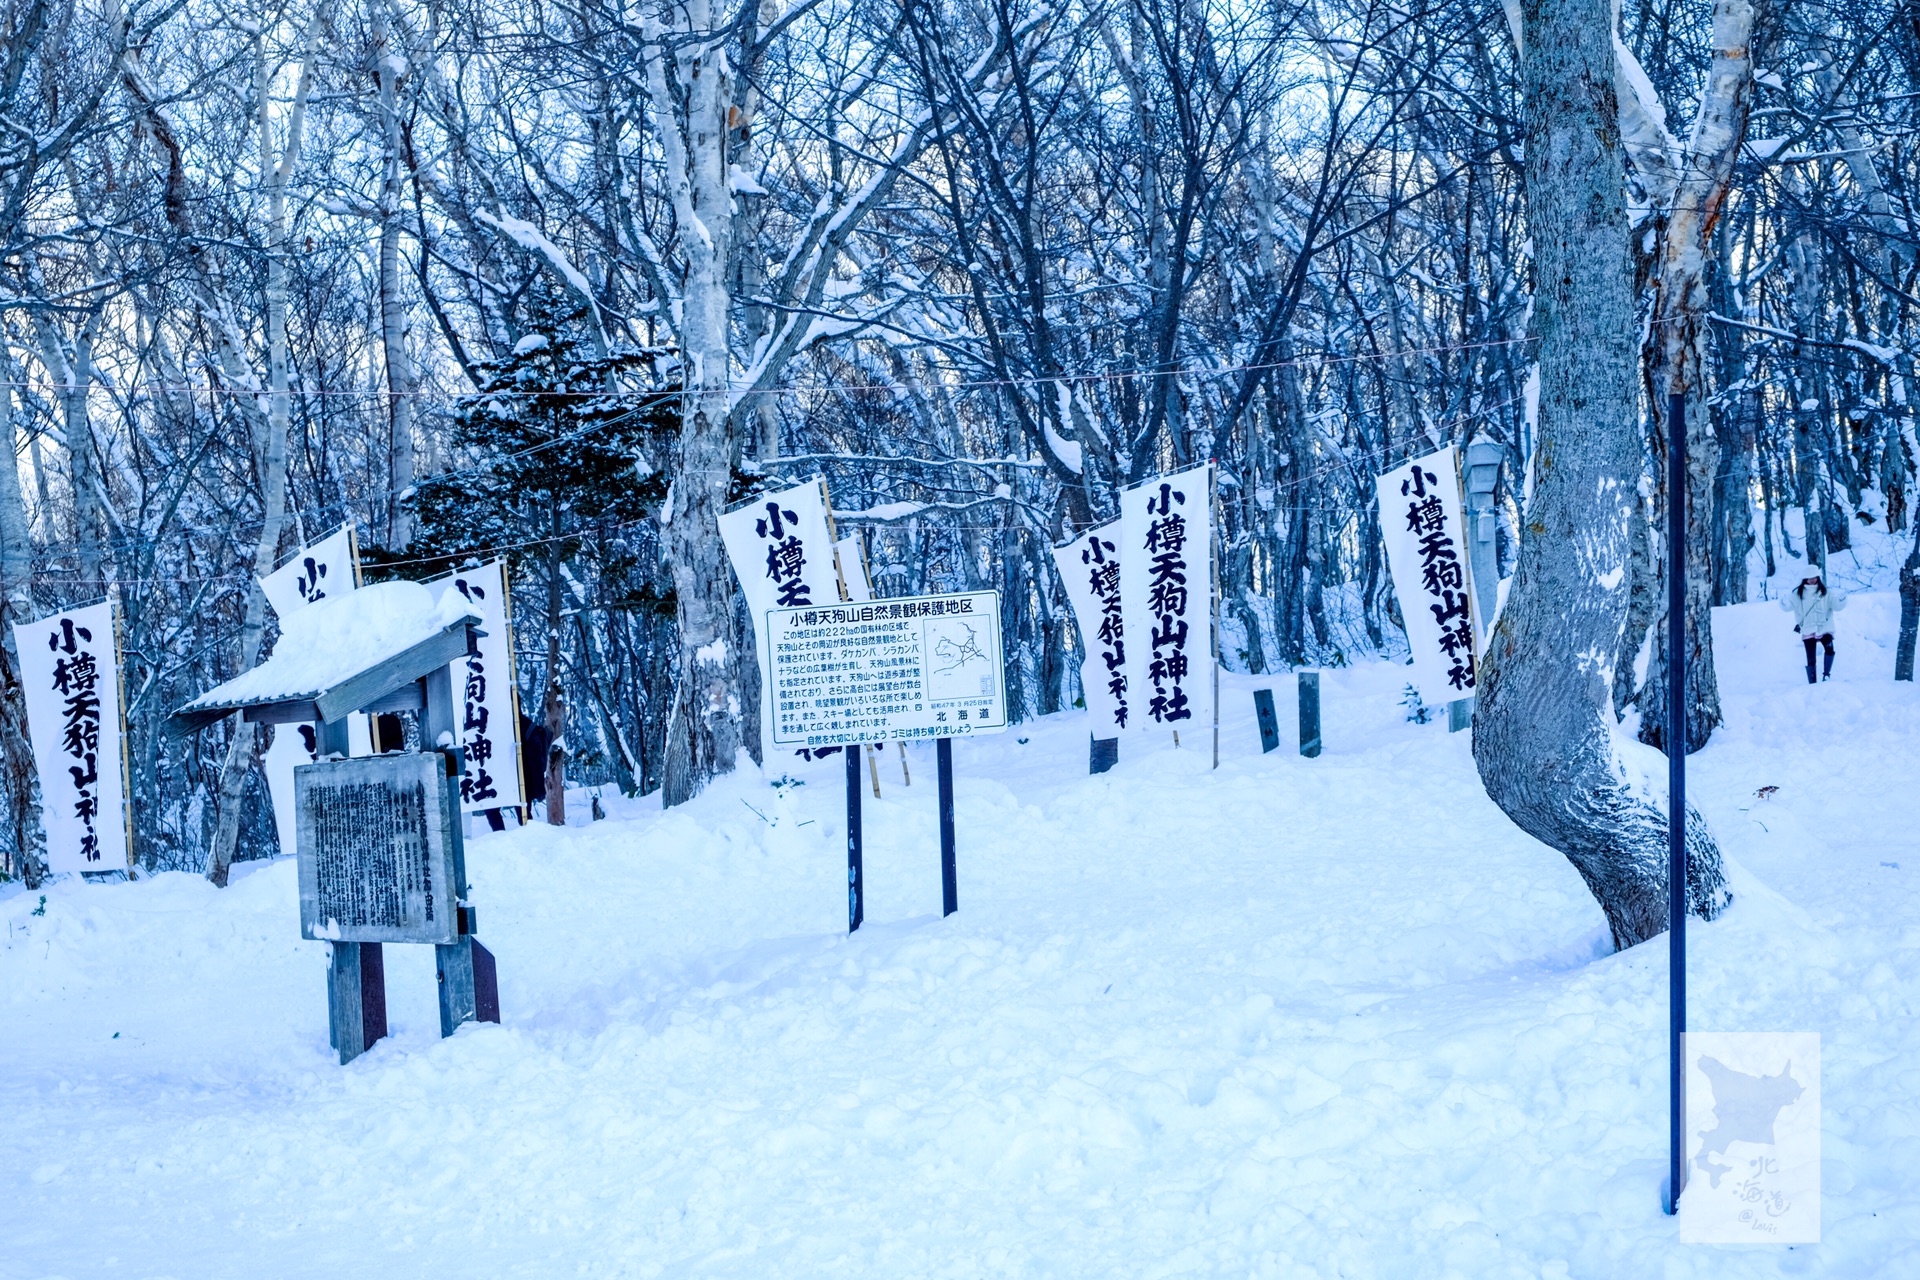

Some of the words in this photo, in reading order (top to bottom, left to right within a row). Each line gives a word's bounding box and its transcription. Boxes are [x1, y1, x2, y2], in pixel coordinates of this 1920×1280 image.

[1400, 465, 1476, 691] 小樽天狗山神社
[789, 599, 974, 627] 小樽天狗山自然景観保護地区
[1144, 483, 1192, 724] 小樽天狗山神社
[936, 708, 990, 722] 北海道
[807, 730, 888, 746] 自然を大切にしましょう
[890, 723, 972, 739] ゴミは持ち帰りましょう
